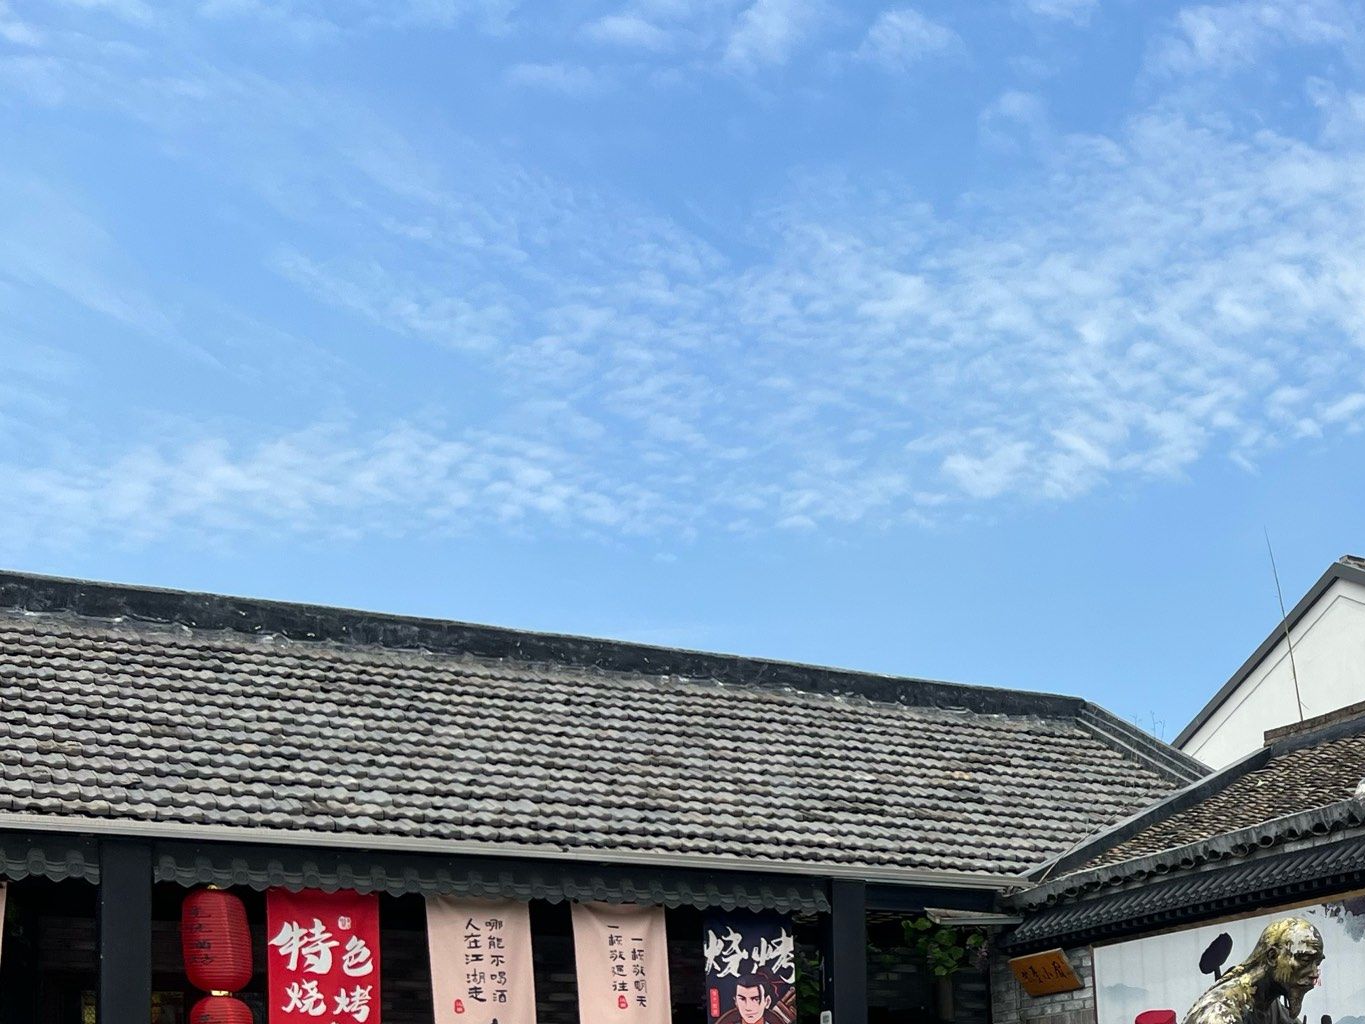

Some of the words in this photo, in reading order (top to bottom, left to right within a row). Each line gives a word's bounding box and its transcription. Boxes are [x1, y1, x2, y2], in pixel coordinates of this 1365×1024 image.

[268, 918, 374, 977] 特色
[464, 918, 487, 1002] 人在江湖走
[485, 918, 508, 1003] 哪能不喝酒
[704, 926, 796, 984] 烧烤
[281, 979, 373, 1023] 烧烤
